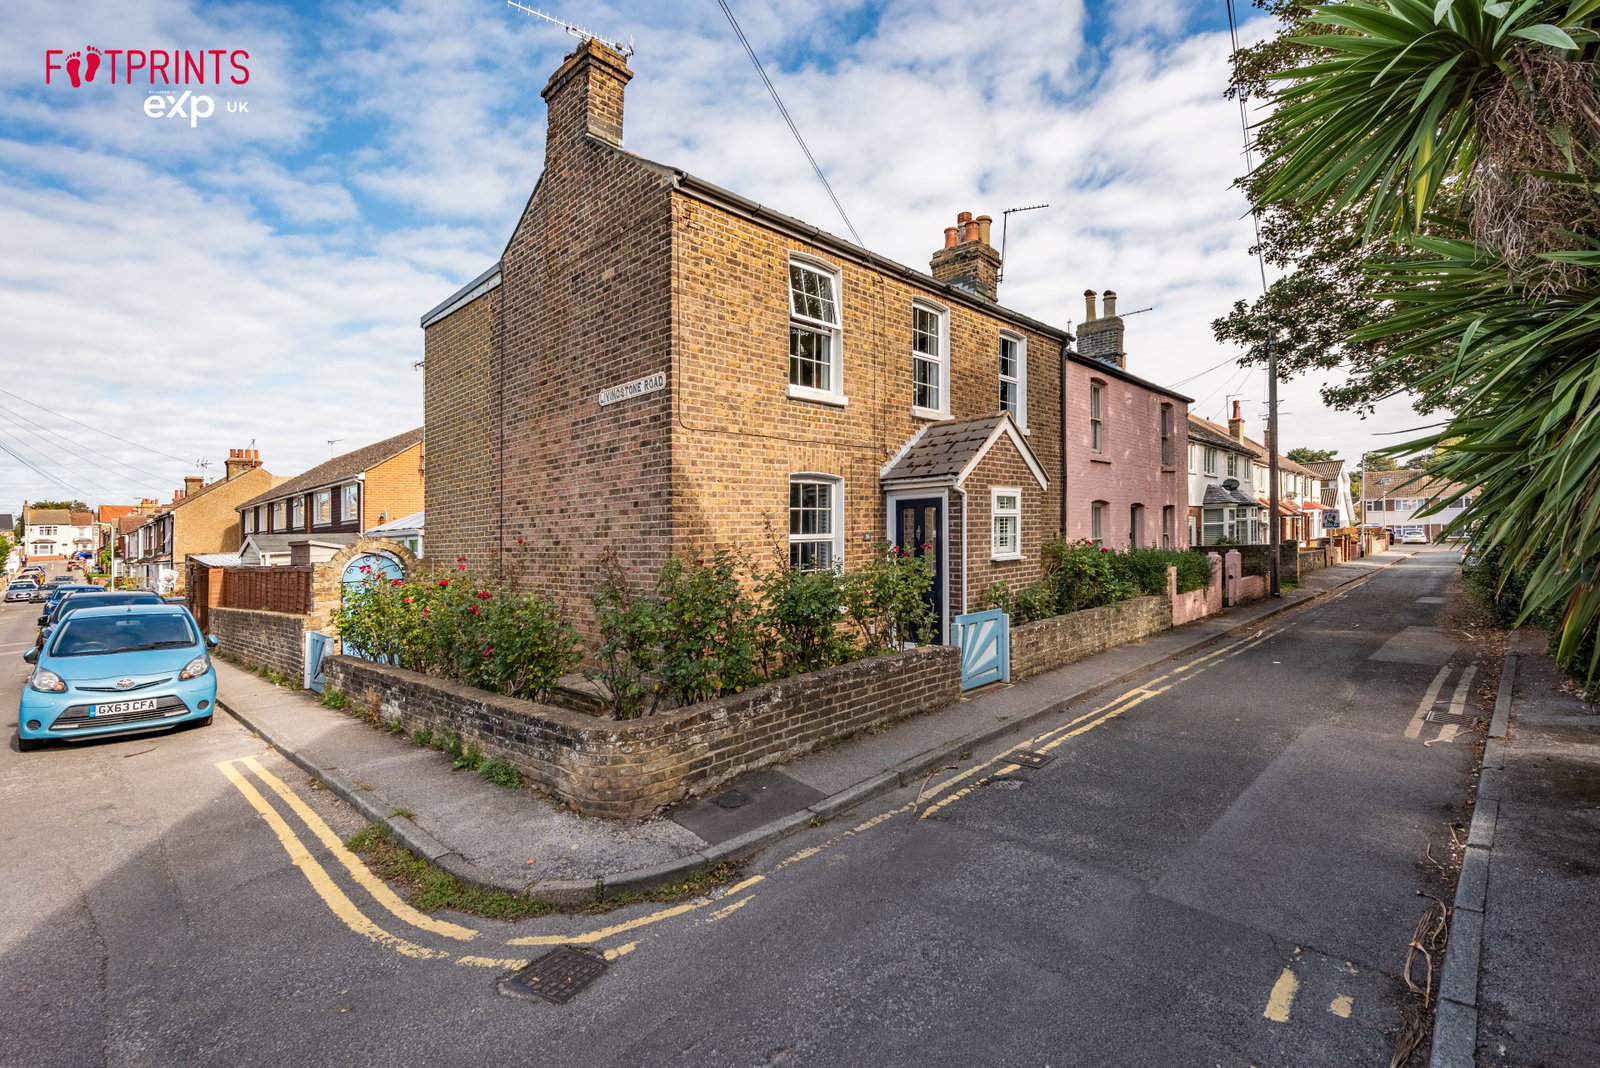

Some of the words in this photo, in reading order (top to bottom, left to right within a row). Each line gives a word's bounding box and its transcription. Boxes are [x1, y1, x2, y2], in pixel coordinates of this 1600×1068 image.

[600, 382, 642, 404] LIVINGSTONE
[644, 375, 664, 391] ROAD
[98, 702, 130, 715] GX63
[132, 700, 155, 711] CFA
